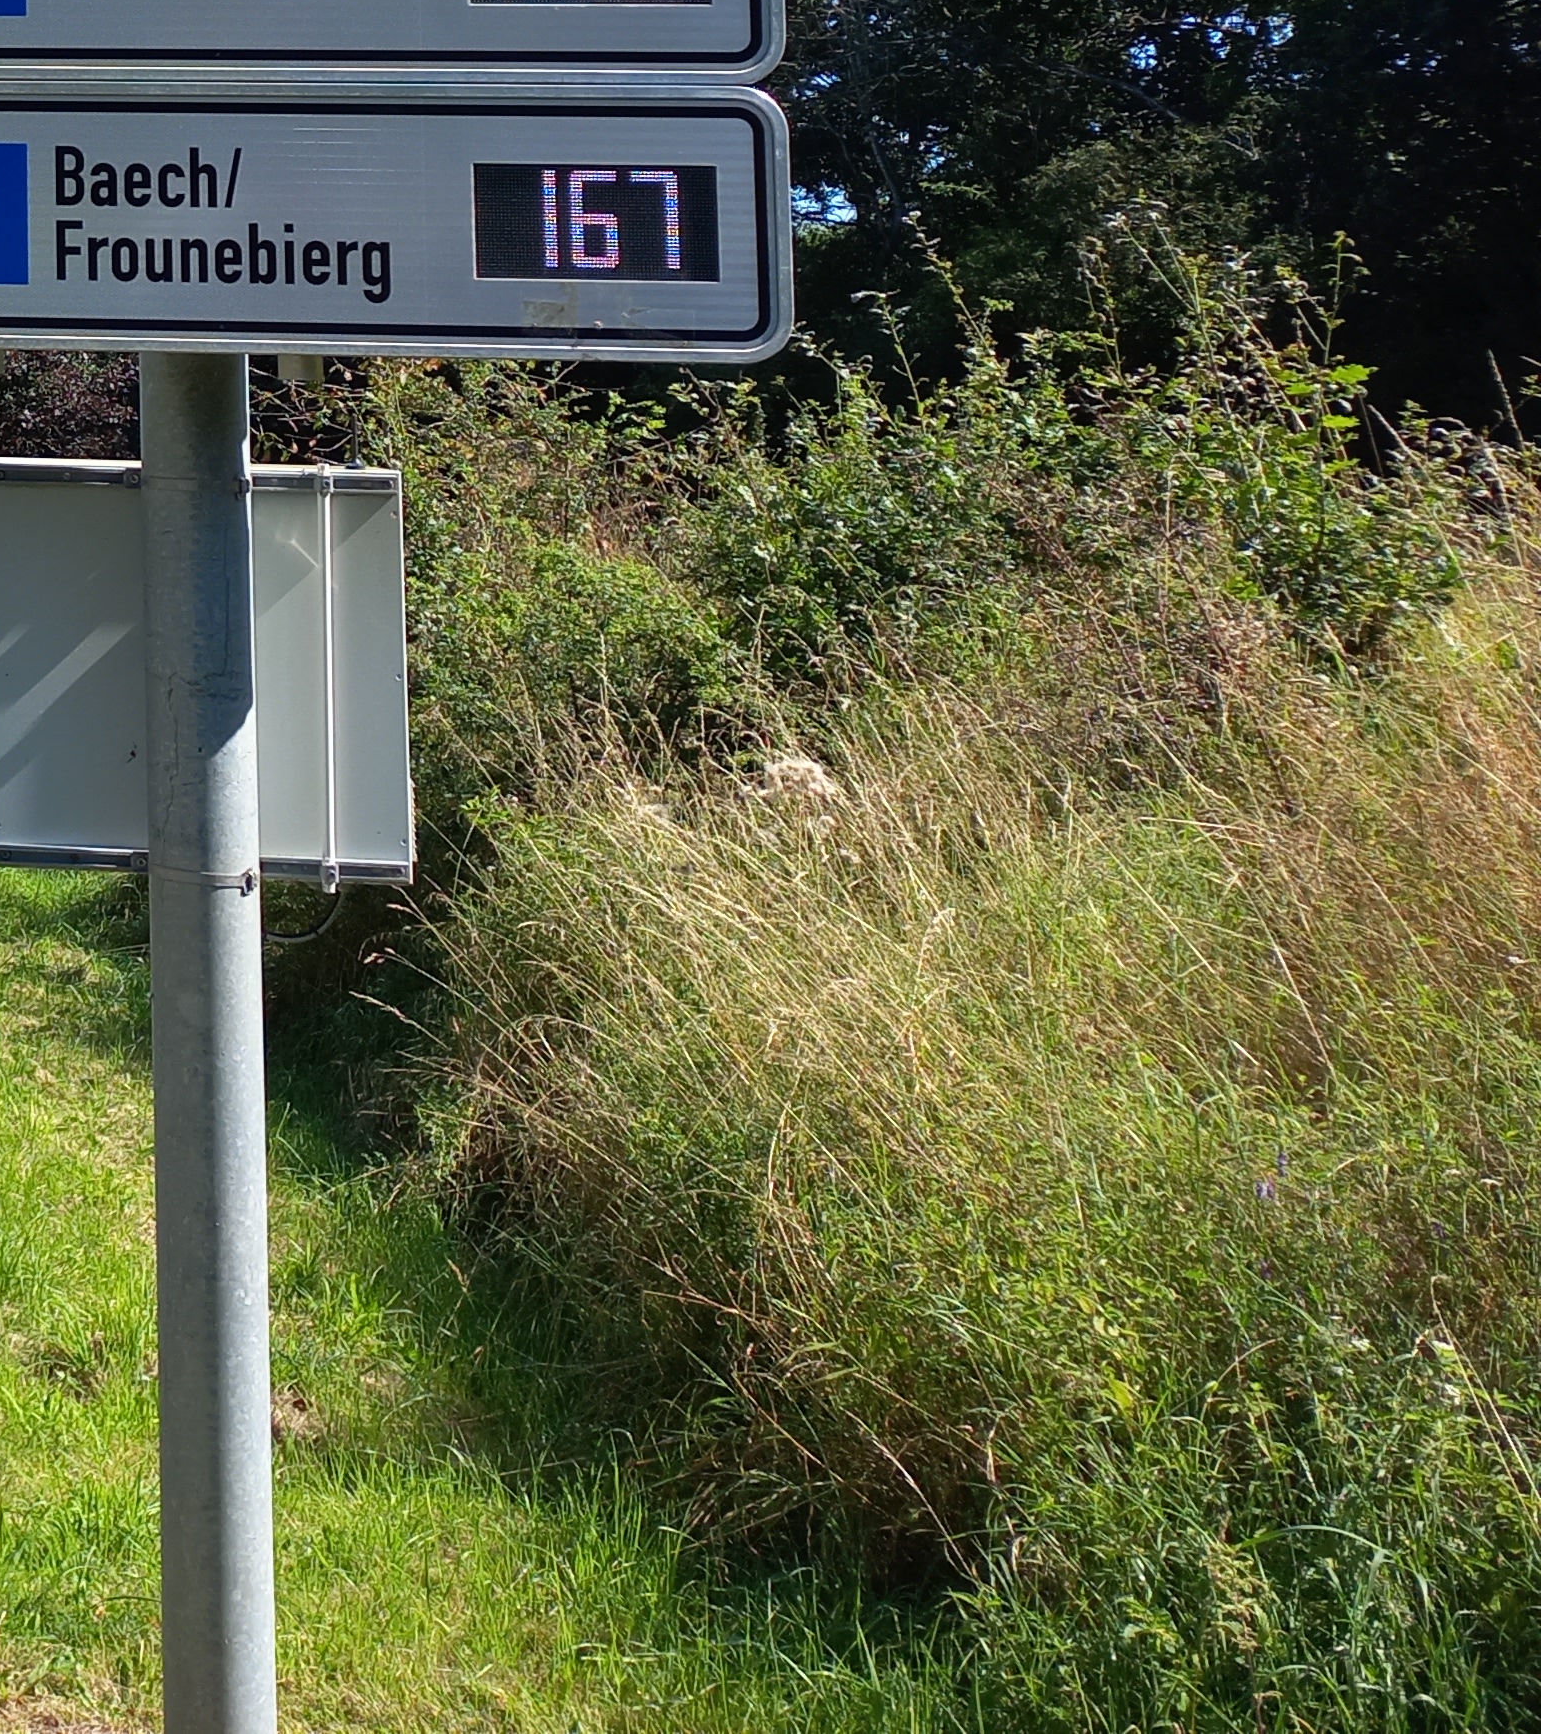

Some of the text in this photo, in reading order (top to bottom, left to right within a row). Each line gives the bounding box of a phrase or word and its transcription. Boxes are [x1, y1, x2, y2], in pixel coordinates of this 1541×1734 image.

[54, 144, 244, 210] Baech/
[539, 168, 683, 271] 167
[55, 218, 393, 305] Frounebierg
